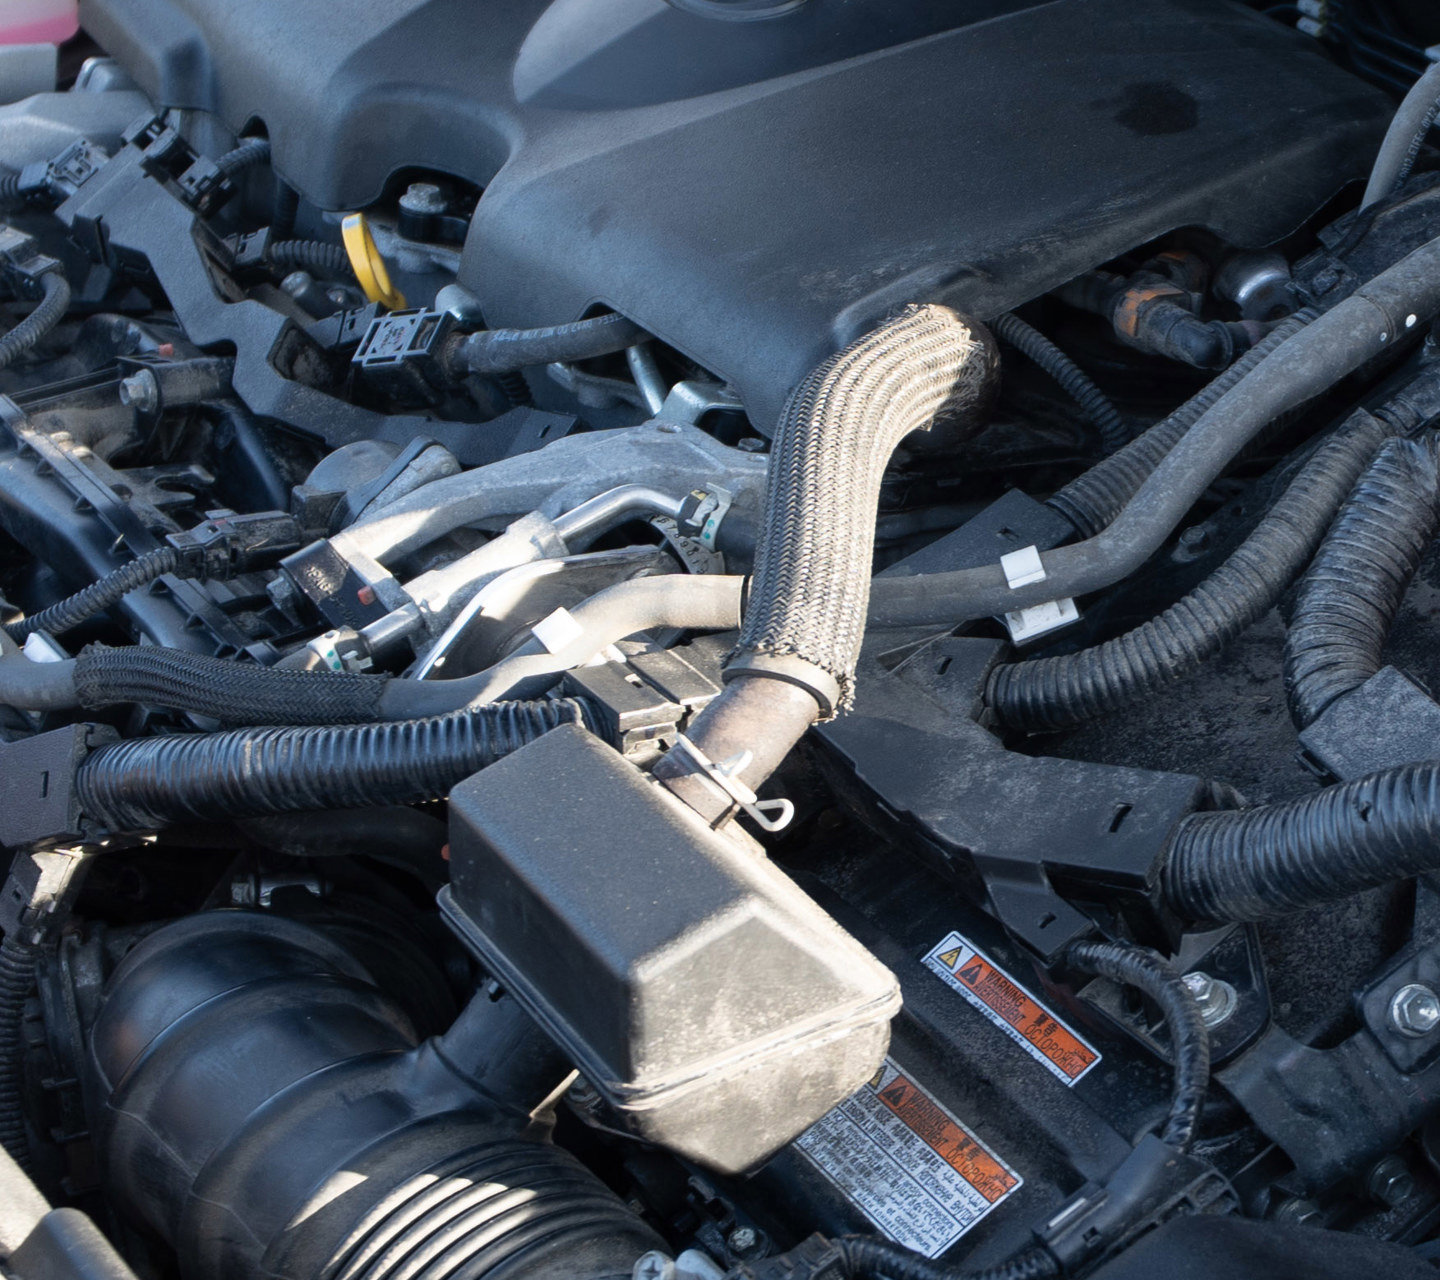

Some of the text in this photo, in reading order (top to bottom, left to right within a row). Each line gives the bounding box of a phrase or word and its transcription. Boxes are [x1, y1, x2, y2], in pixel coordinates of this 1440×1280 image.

[971, 979, 1026, 1026] AVERTISSEMENT
[983, 969, 1027, 1008] WARNING
[1032, 1012, 1060, 1037] 警告
[1021, 1022, 1084, 1077] ОСТОРОЖНО
[907, 1091, 951, 1131] WARNING
[944, 1146, 1004, 1200] ОСТОРОЖНО
